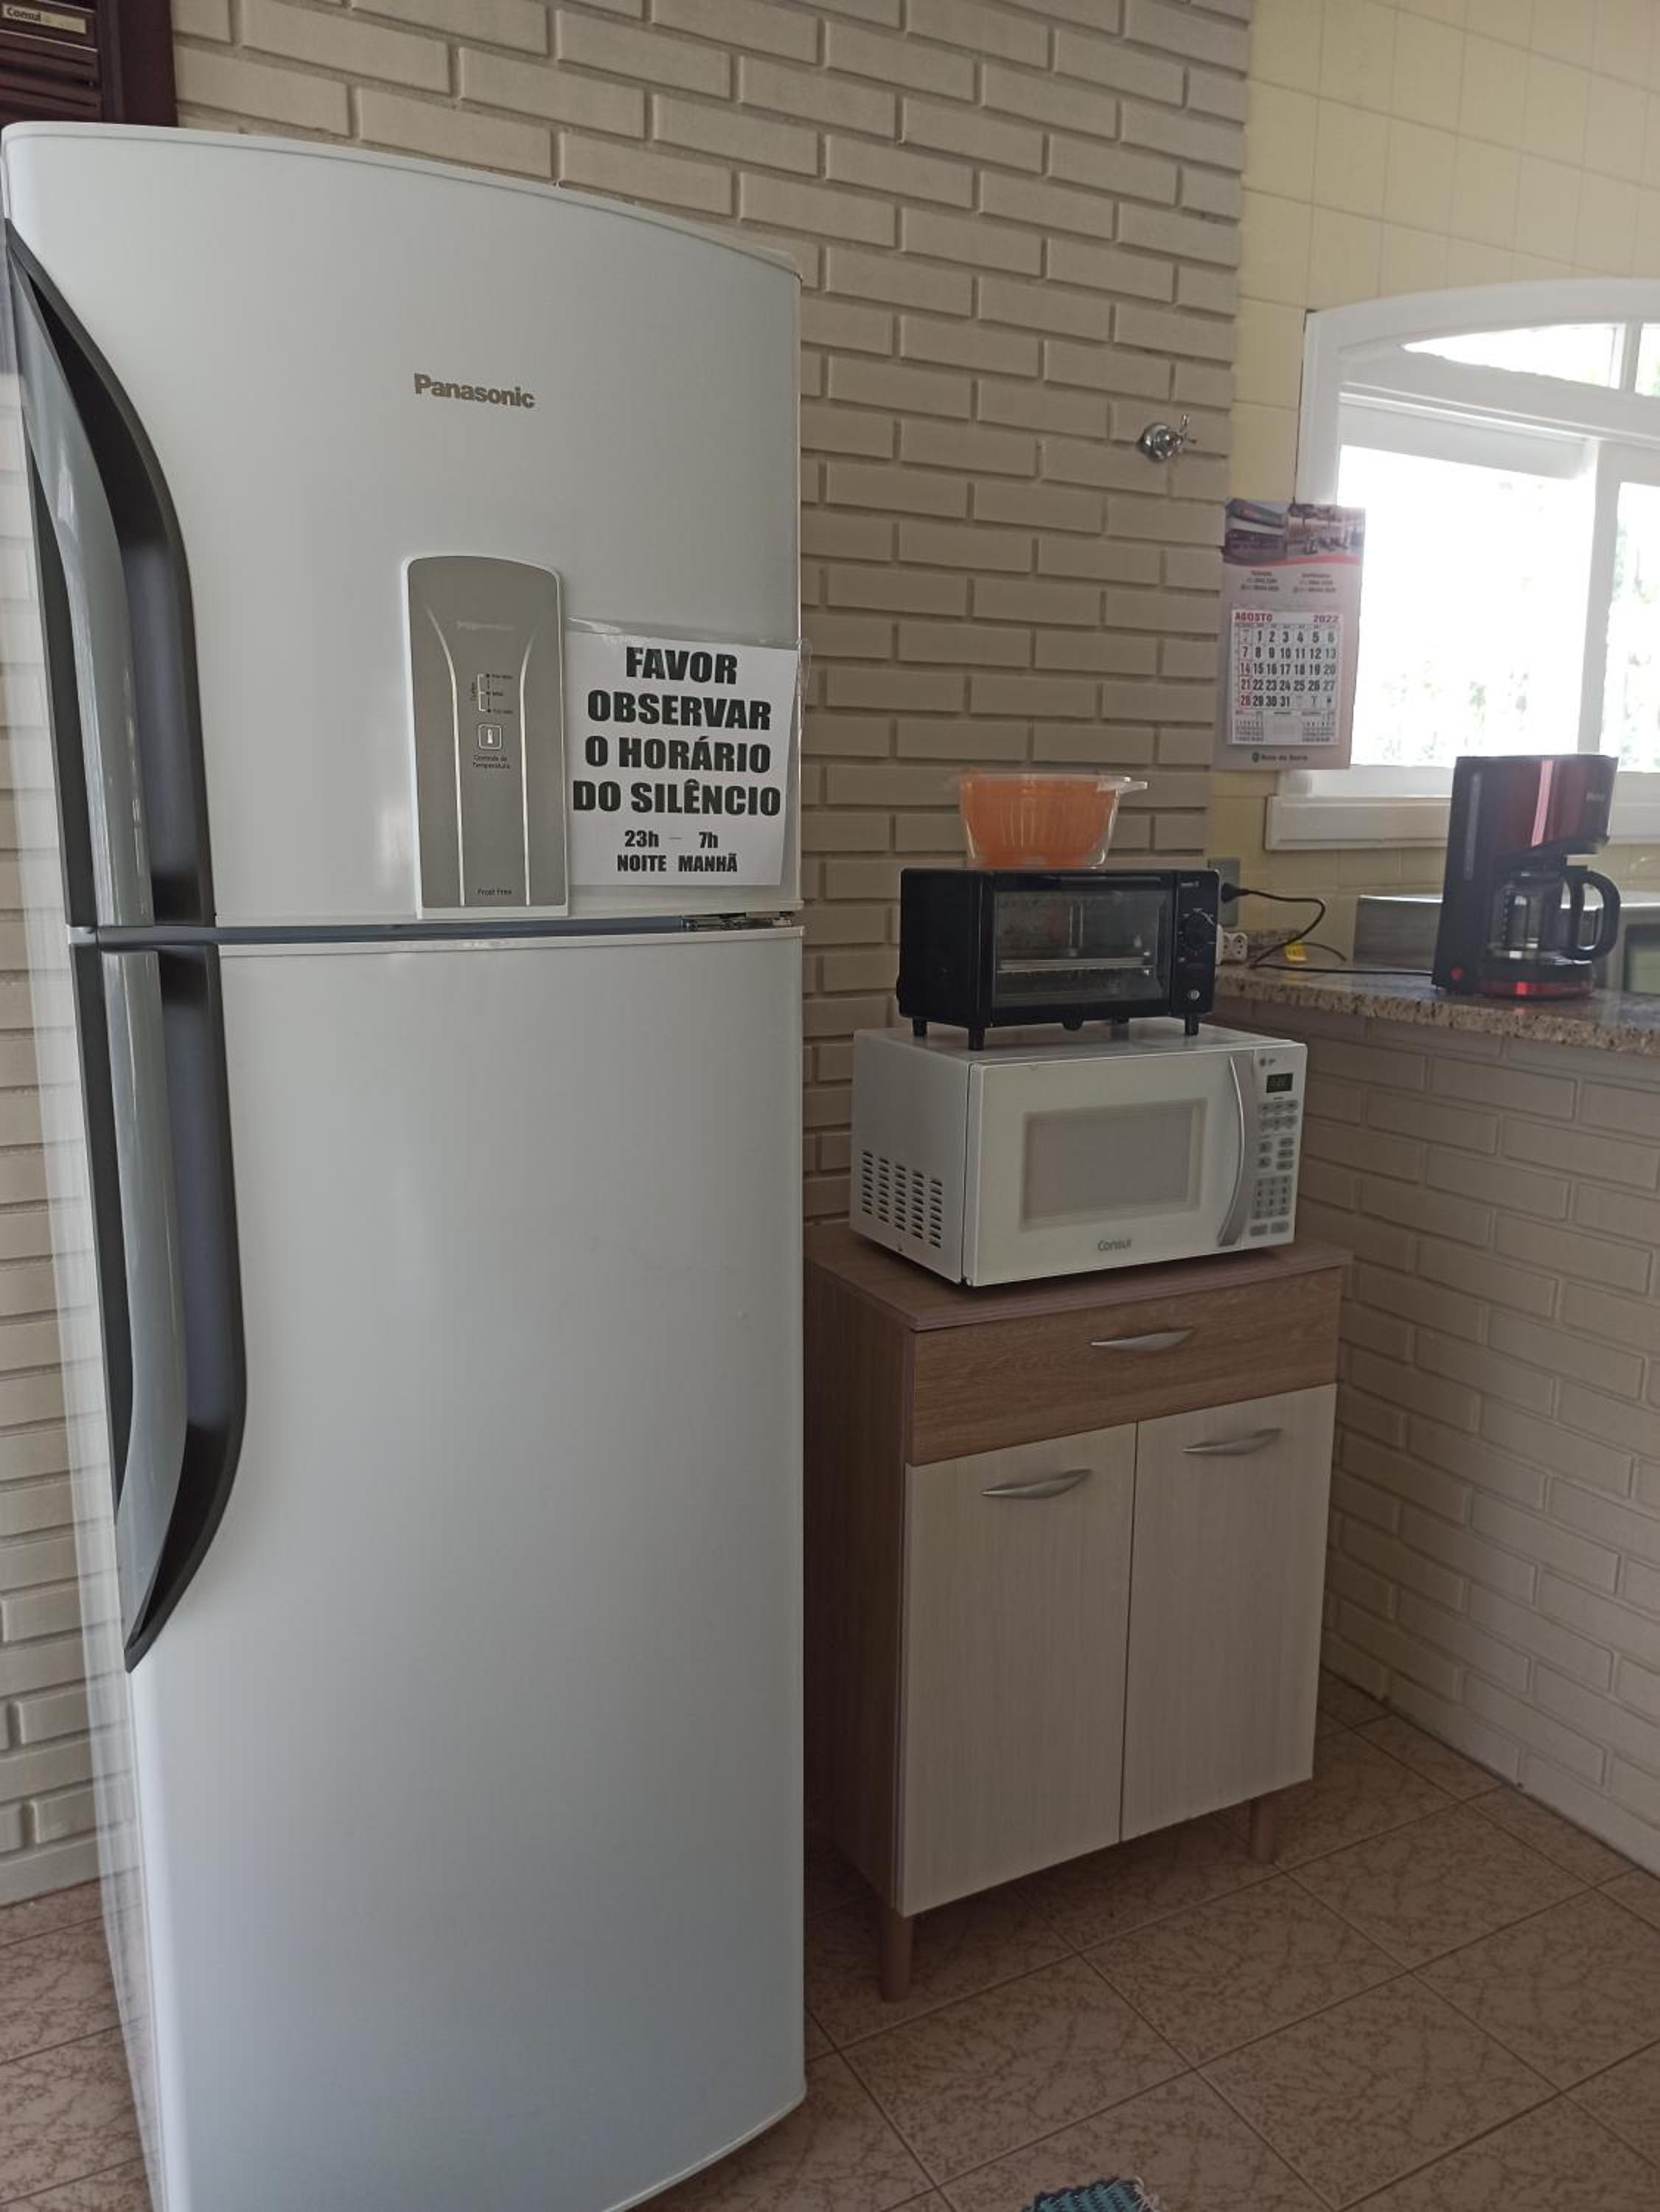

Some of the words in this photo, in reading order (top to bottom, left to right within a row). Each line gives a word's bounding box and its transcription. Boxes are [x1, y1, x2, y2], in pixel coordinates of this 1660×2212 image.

[7, 7, 41, 23] Consul
[414, 372, 536, 408] Panasonic
[1235, 611, 1273, 622] AGOSTO
[1312, 613, 1339, 624] 2022
[1280, 647, 1291, 659] 10
[1296, 647, 1305, 660] 11
[1310, 647, 1322, 660] 12
[1326, 647, 1336, 660] 13
[626, 646, 737, 685] FAVOR
[1241, 662, 1250, 674] 14
[1253, 663, 1264, 675] 15
[1266, 663, 1277, 675] 16
[1280, 663, 1291, 675] 17
[1295, 664, 1305, 675] 18
[1309, 664, 1320, 675] 19
[1323, 664, 1336, 675] 20
[1241, 678, 1250, 691] 21
[1252, 678, 1264, 691] 22
[1266, 679, 1277, 692] 23
[1279, 679, 1291, 692] 24
[1294, 679, 1305, 692] 25
[1308, 680, 1320, 692] 26
[1323, 680, 1335, 692] 27
[1241, 694, 1251, 706] 28
[1252, 695, 1264, 707] 29
[1266, 695, 1277, 707] 30
[1280, 695, 1290, 707] 31
[587, 689, 772, 730] OBSERVAR
[585, 735, 608, 767] O
[618, 735, 771, 773] HORÁRIO
[573, 780, 621, 812] DO
[630, 779, 781, 816] SILÊNCIO
[624, 830, 659, 848] 23h
[699, 831, 719, 849] 7h
[617, 854, 666, 872] NOITE
[678, 852, 738, 873] MANHÃ
[1098, 1237, 1132, 1252] Consul
